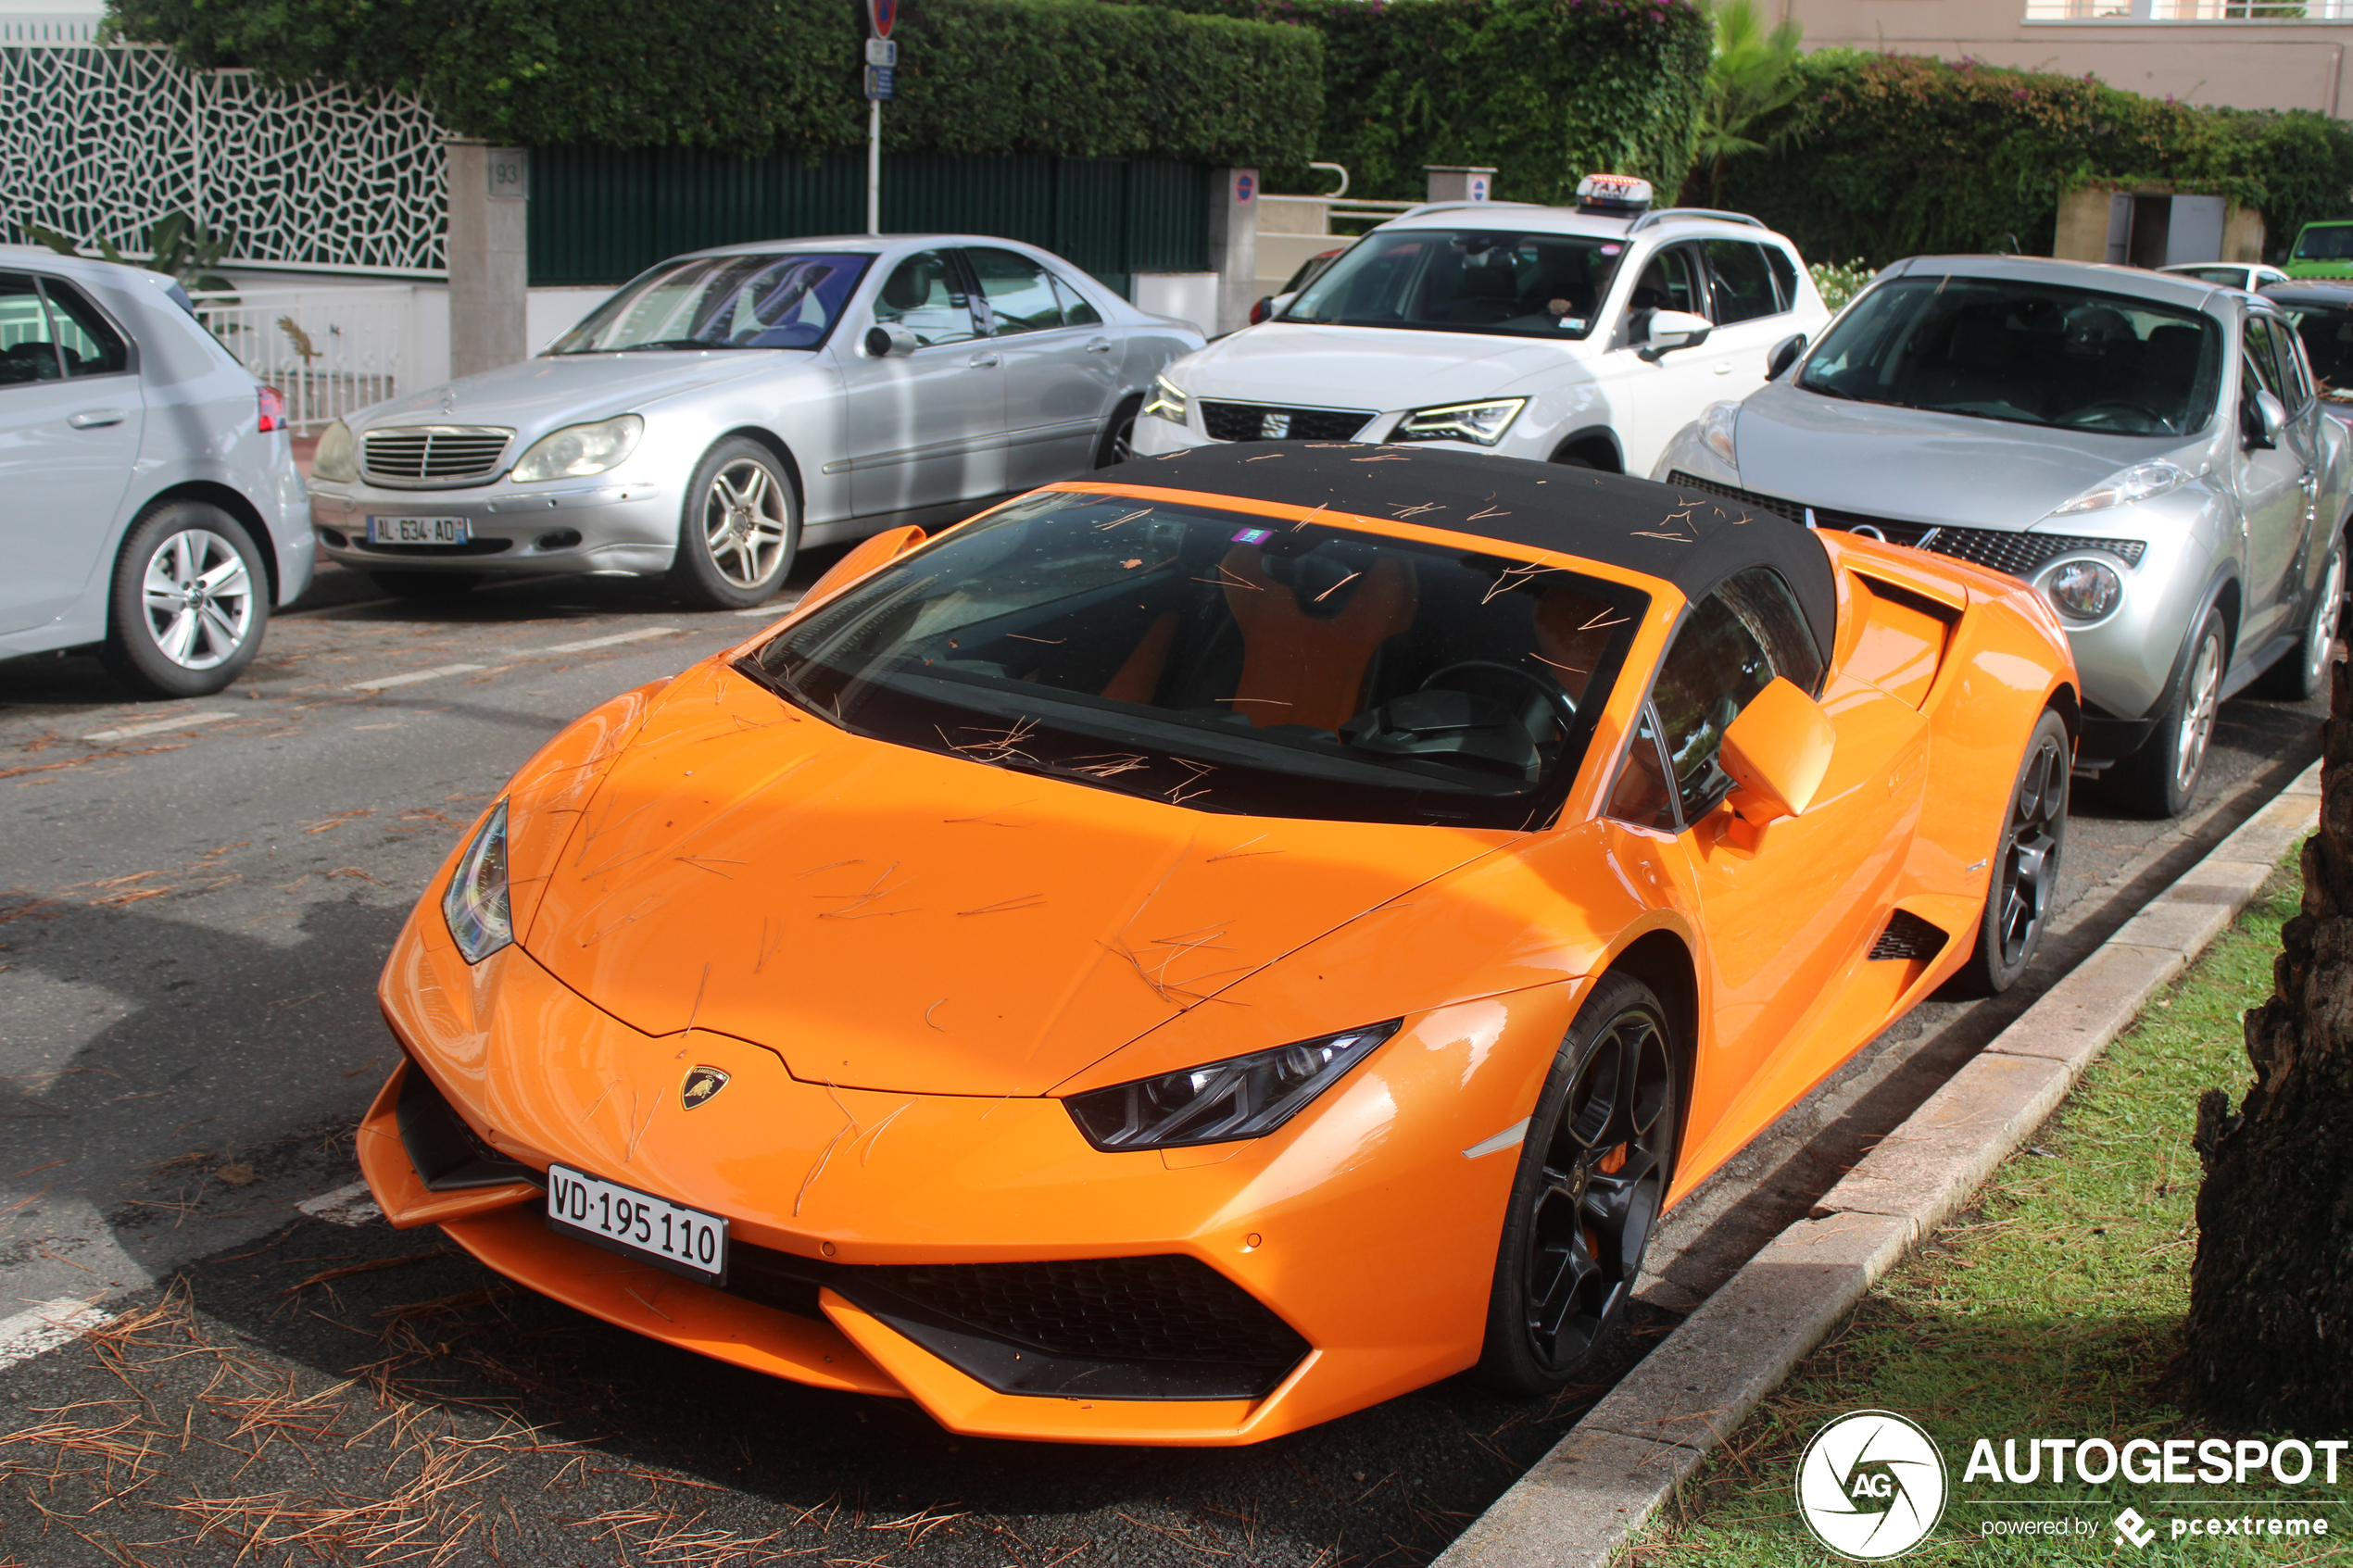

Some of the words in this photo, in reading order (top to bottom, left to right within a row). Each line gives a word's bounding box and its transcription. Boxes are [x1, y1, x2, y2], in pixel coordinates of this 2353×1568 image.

[496, 163, 517, 184] 93
[1590, 182, 1630, 195] TAXI
[693, 1068, 727, 1083] LAMBORG
